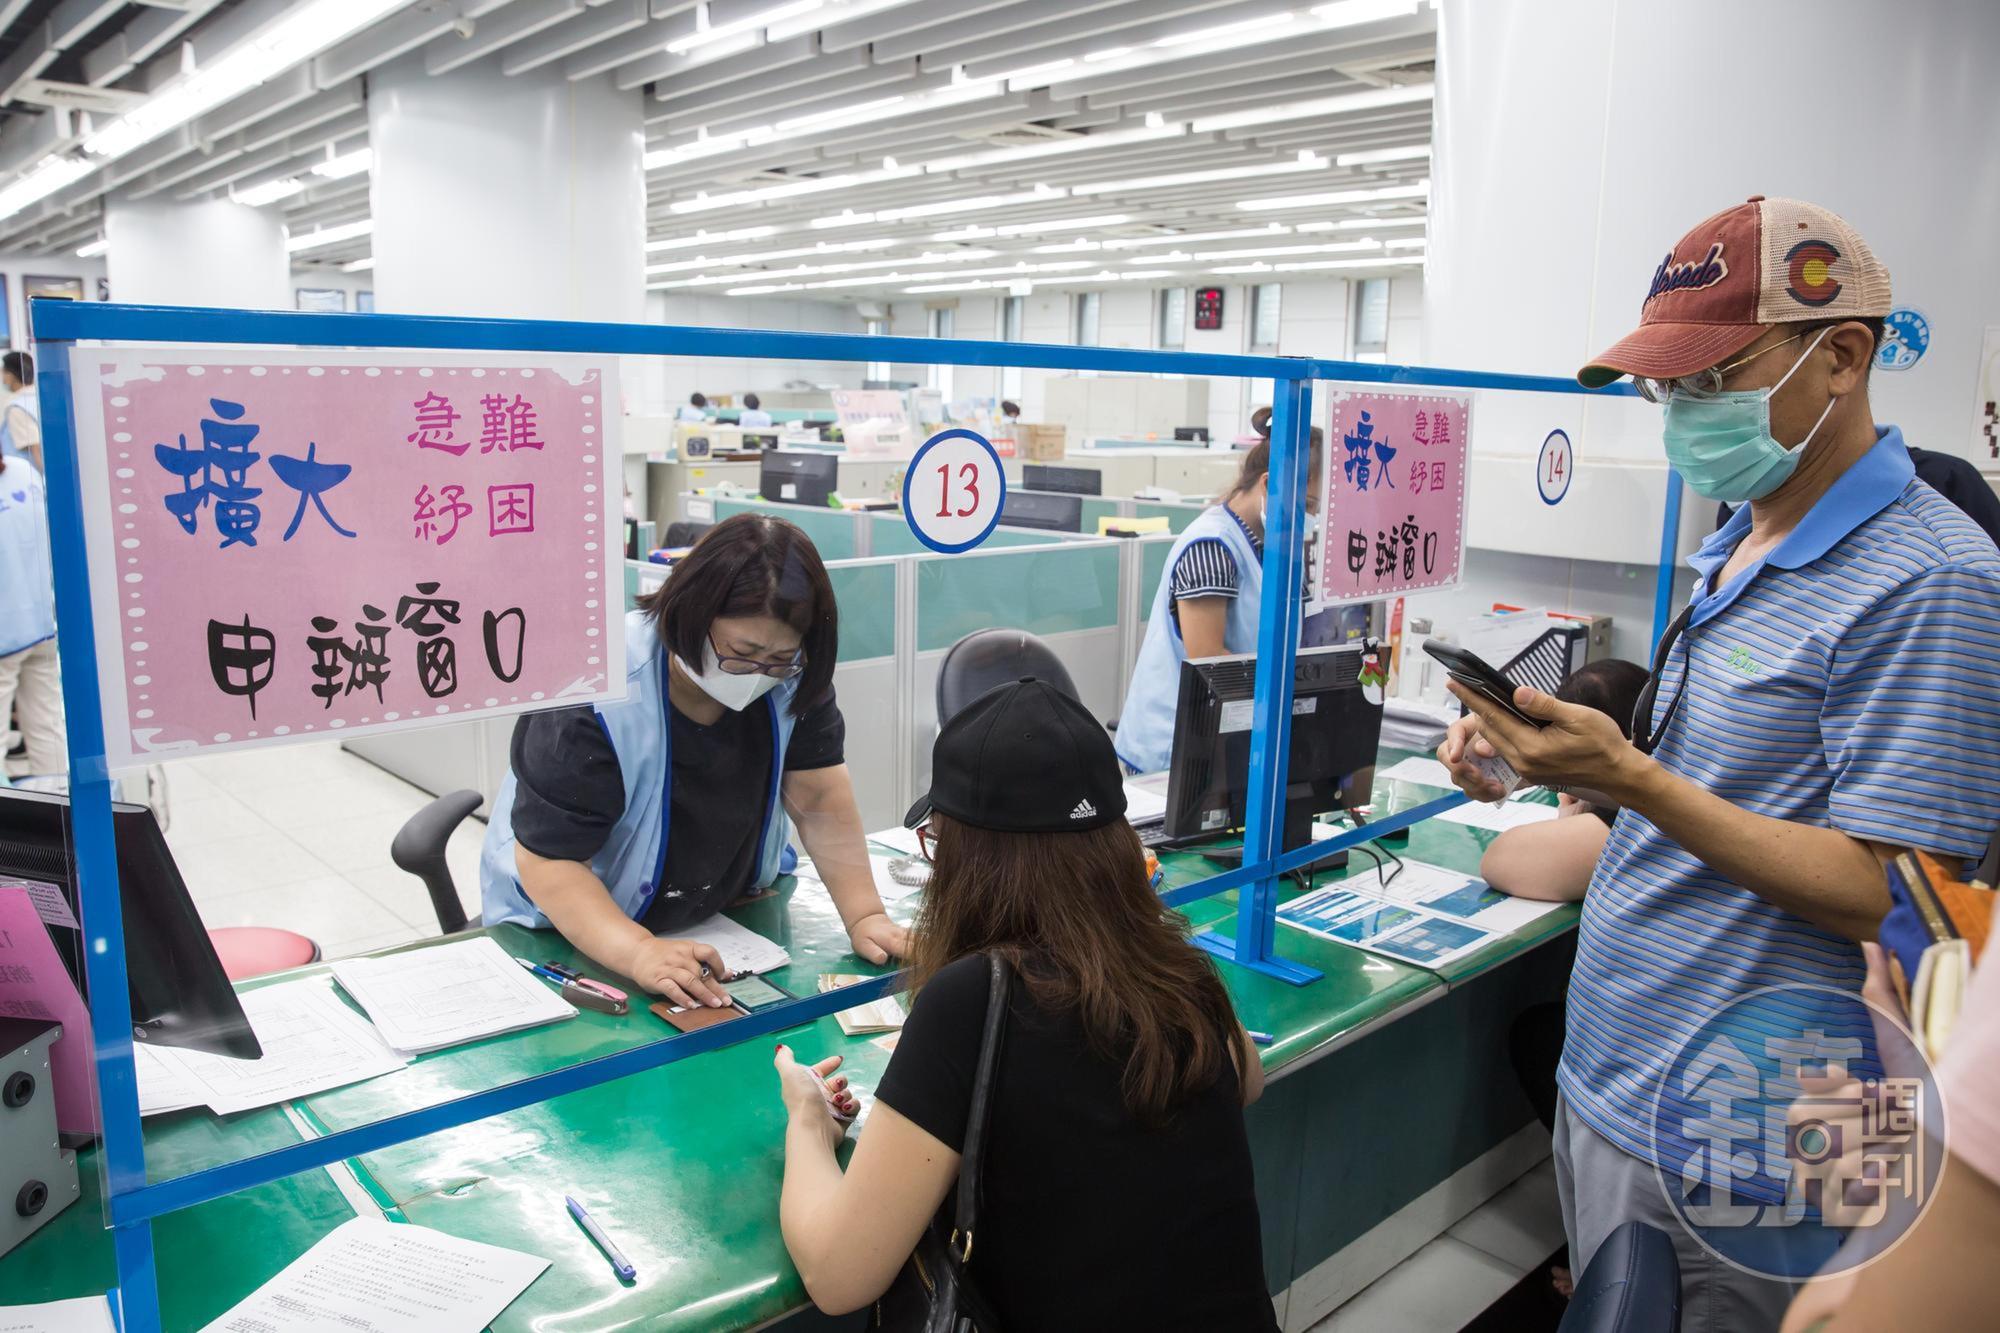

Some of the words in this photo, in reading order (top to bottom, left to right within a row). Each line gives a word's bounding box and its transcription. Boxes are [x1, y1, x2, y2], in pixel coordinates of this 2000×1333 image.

[407, 391, 545, 457] 急難
[1344, 410, 1397, 492] 擴大
[1412, 409, 1451, 446] 急難
[154, 398, 357, 549] 擴大
[936, 463, 980, 518] 13
[1409, 460, 1446, 496] 紓困
[1547, 449, 1564, 484] 14
[413, 482, 536, 545] 紓困
[1347, 514, 1438, 587] 申辦窗口
[207, 581, 527, 721] 申辦窗口
